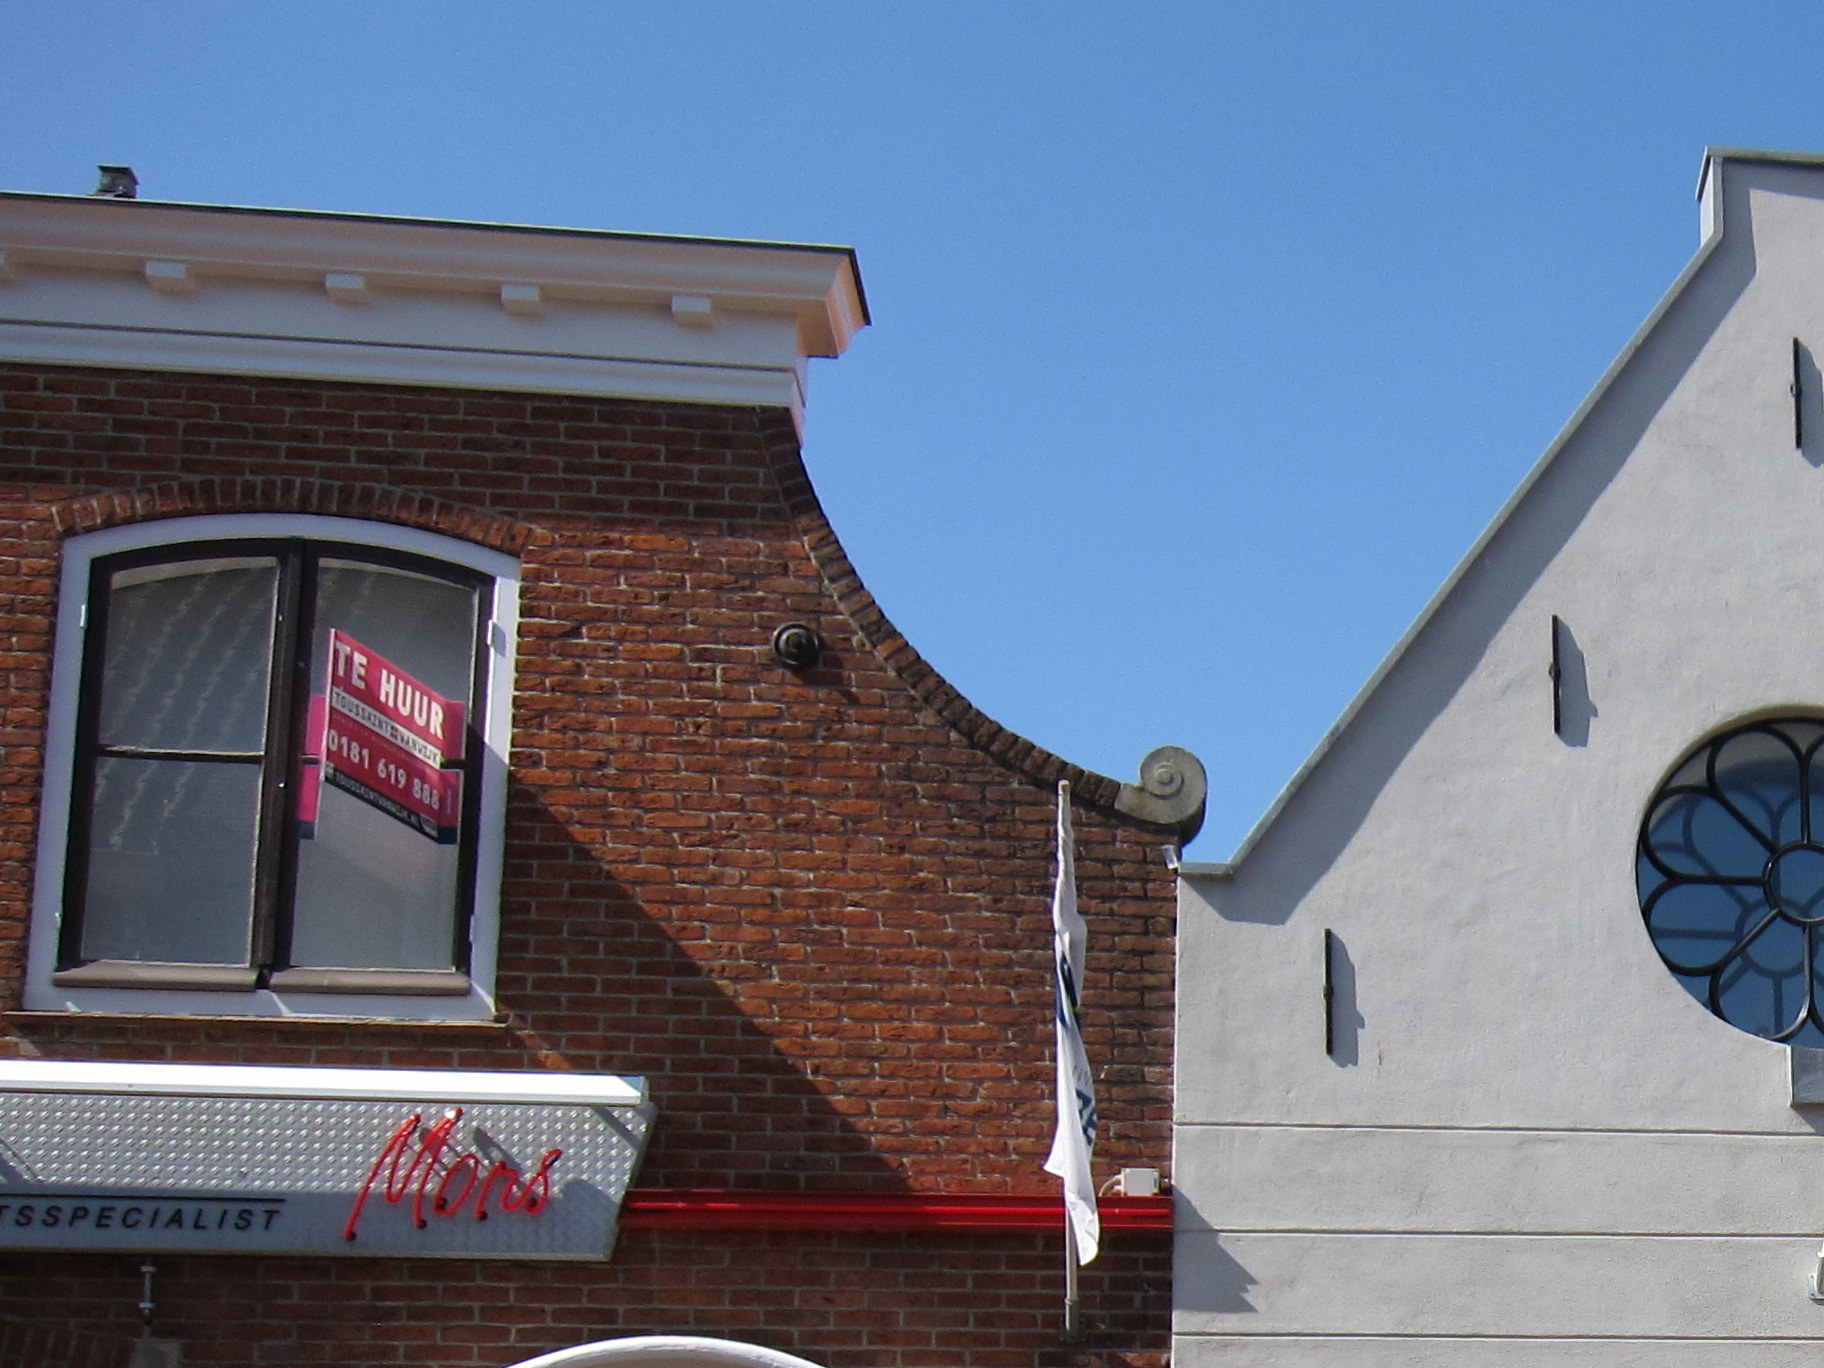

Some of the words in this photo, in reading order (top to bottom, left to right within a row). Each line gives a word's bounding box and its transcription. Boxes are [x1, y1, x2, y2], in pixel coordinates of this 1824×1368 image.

[335, 640, 367, 690] TE
[379, 668, 444, 740] HUUR
[328, 729, 370, 770] 0181
[377, 758, 407, 789] 619
[412, 778, 441, 810] 888
[343, 1107, 562, 1240] Mons
